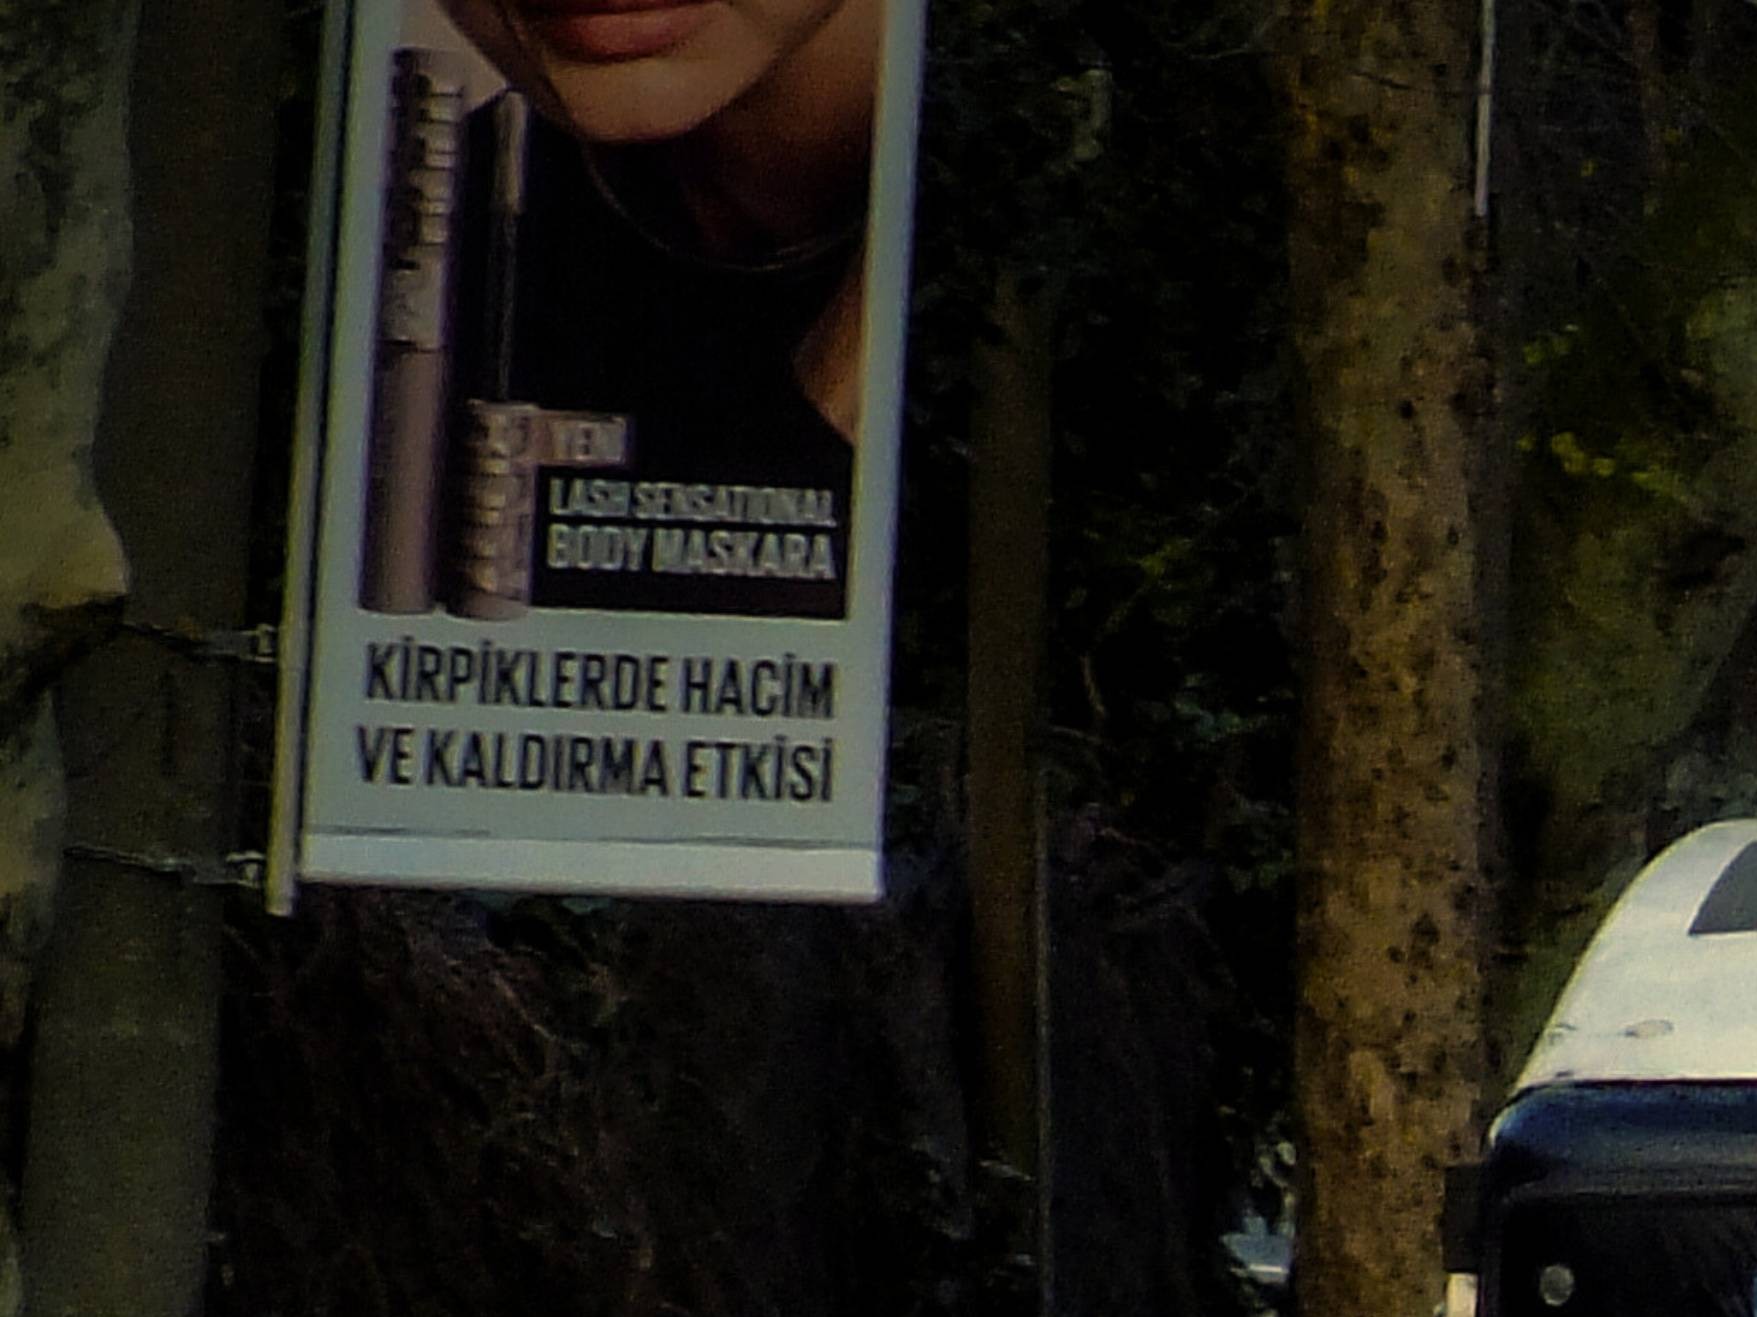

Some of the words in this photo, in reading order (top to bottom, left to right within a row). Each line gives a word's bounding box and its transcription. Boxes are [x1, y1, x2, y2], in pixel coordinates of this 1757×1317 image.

[548, 523, 648, 571] BODY
[651, 527, 837, 580] MASKARA
[365, 635, 669, 713] KİRPİKLERDE
[680, 652, 838, 720] HACİM
[356, 724, 414, 786] VE
[425, 727, 671, 797] KALDIRMA
[684, 734, 834, 802] ETKİSİ
